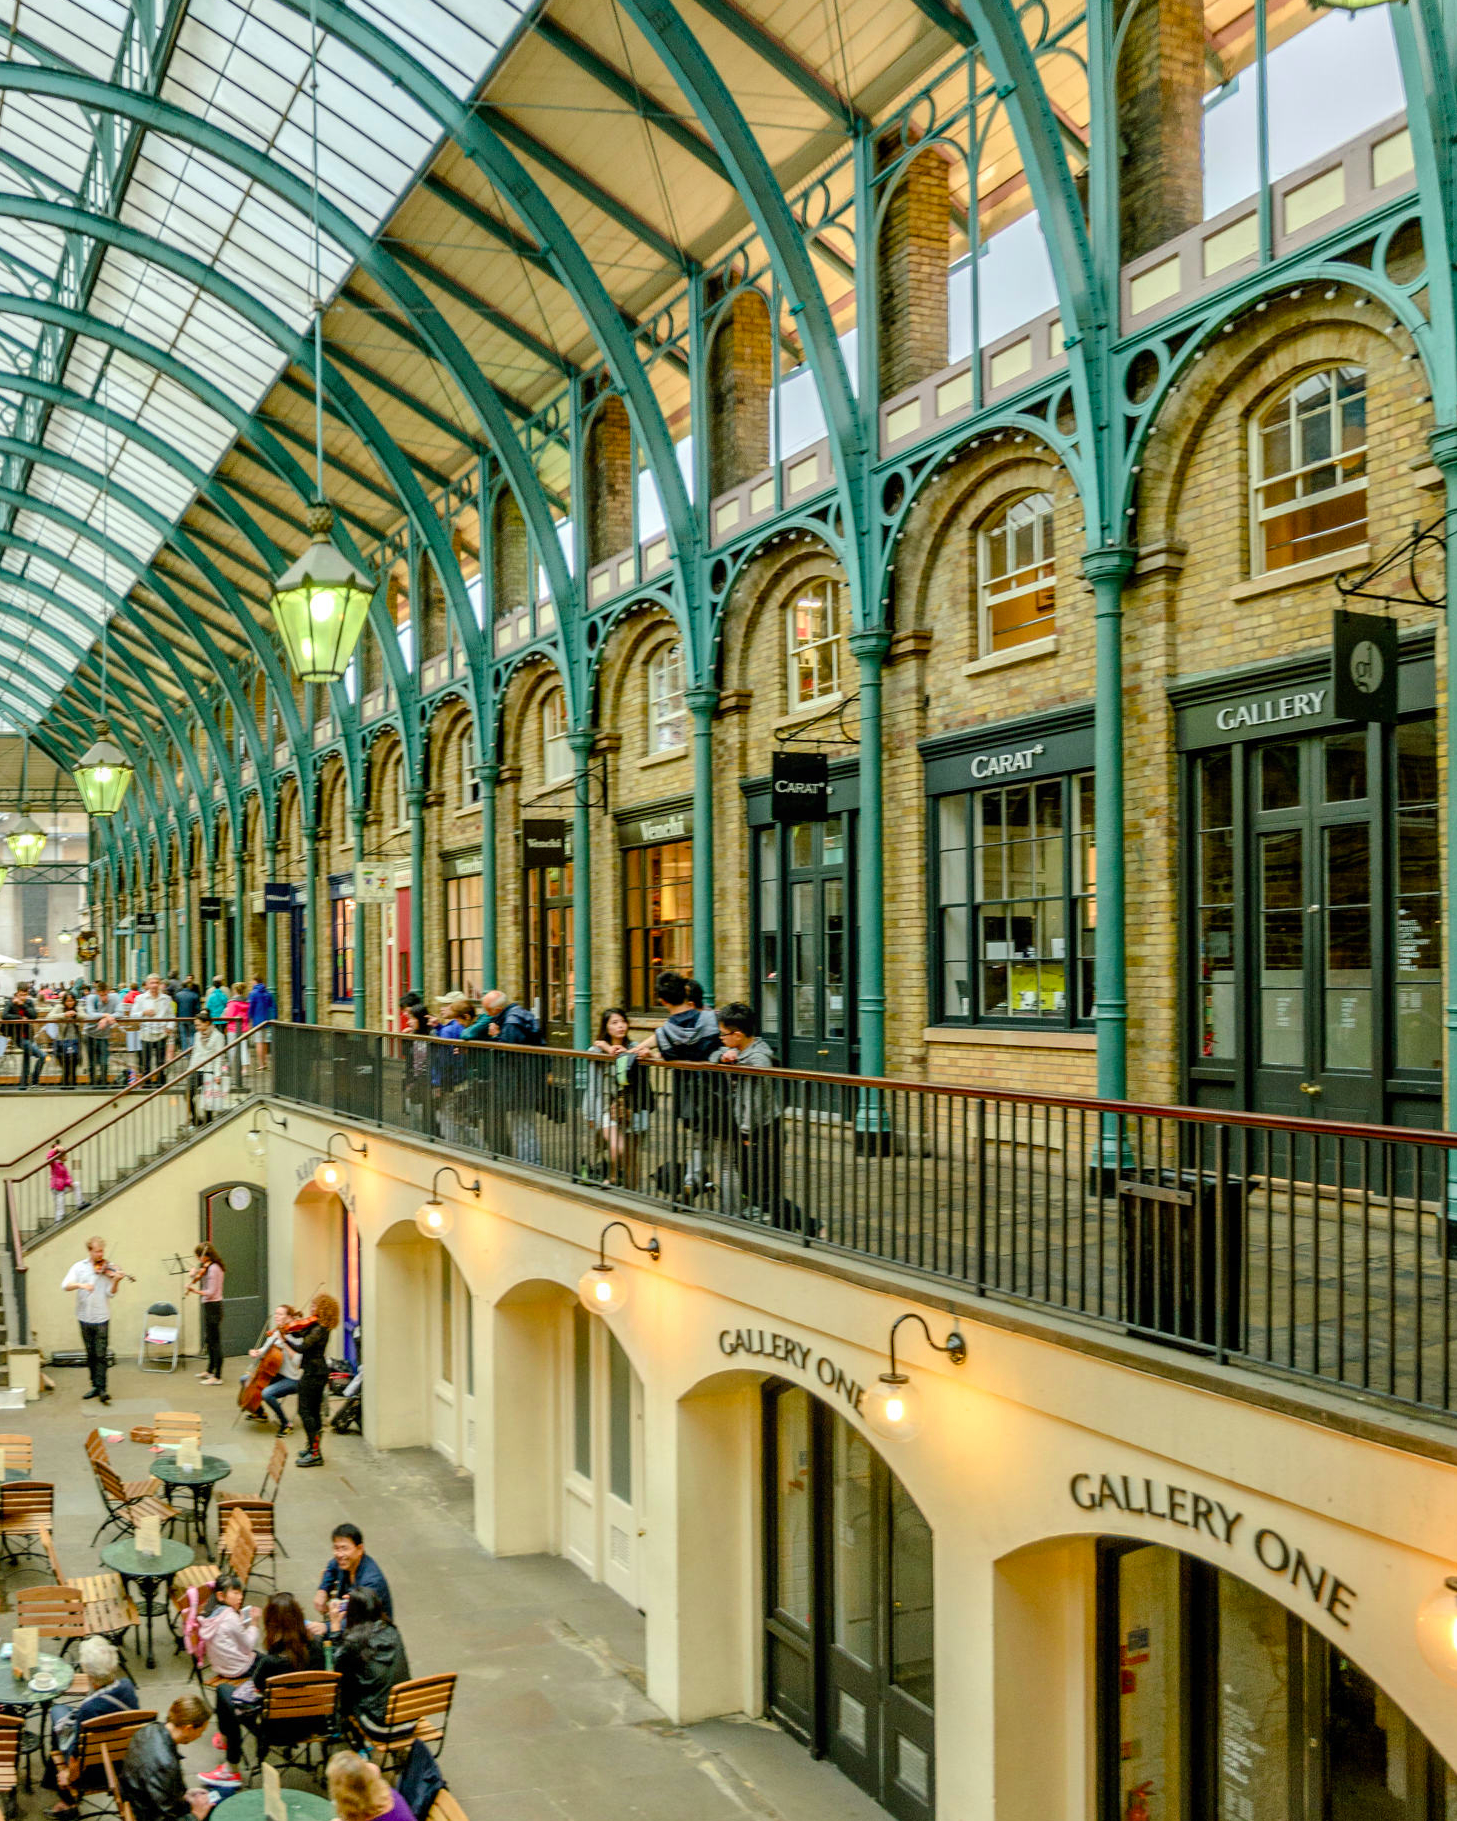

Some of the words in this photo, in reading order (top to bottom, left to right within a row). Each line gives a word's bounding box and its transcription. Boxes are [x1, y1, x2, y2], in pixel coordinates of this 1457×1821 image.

[1216, 690, 1326, 730] GALLERY
[639, 814, 685, 841] Venchi
[719, 1329, 811, 1369] GALLERY
[817, 1357, 865, 1418] ONE
[1070, 1473, 1243, 1545] GALLERY
[1254, 1528, 1357, 1627] ONE
